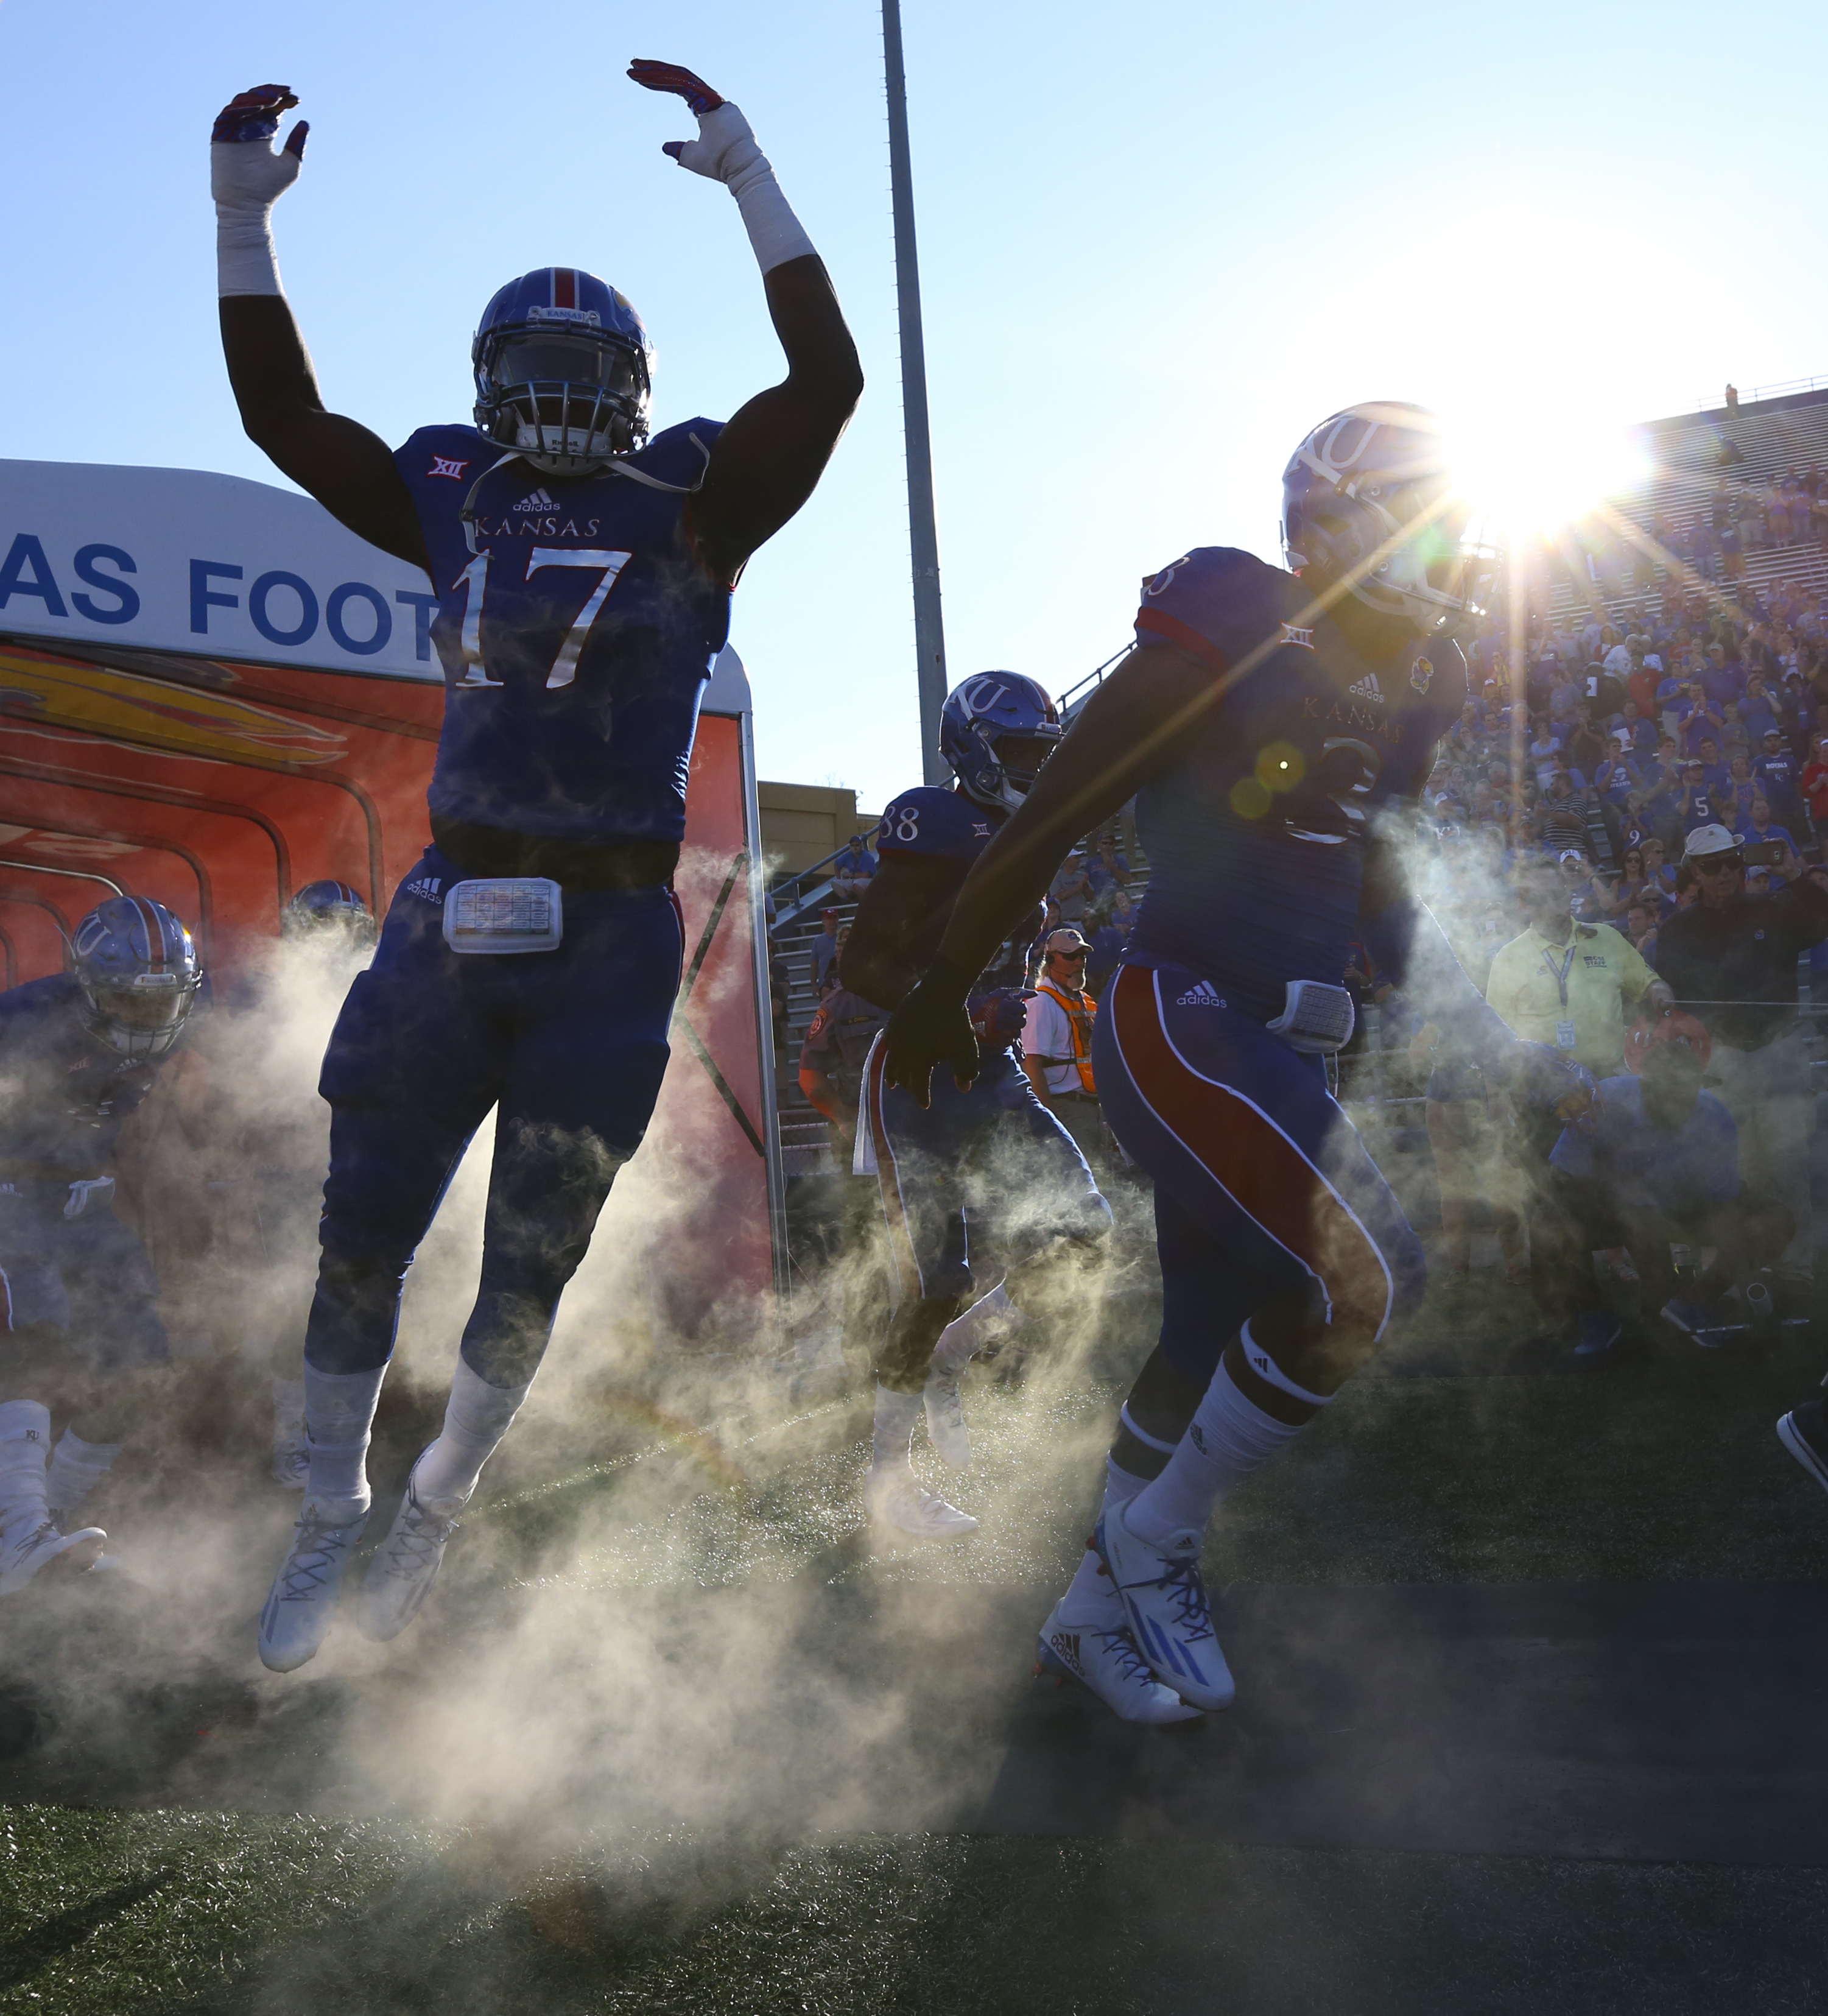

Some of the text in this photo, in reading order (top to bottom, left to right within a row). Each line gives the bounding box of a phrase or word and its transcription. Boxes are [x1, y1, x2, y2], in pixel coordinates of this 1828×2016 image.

[547, 310, 583, 320] KANSAS
[428, 455, 468, 480] XII
[513, 501, 561, 512] adidas
[473, 517, 600, 537] KANSAS
[0, 532, 440, 662] AS FOOT
[452, 546, 633, 689] 17
[1280, 622, 1315, 650] XII
[949, 675, 1011, 721] KU
[1349, 685, 1385, 703] adidas
[1301, 697, 1405, 744] KANSAS
[1695, 797, 1709, 817] 5
[879, 805, 919, 841] 88
[1629, 830, 1640, 846] 9
[407, 883, 442, 904] adidas
[1176, 995, 1227, 1008] adidas
[26, 1429, 40, 1440] KU
[1050, 1635, 1085, 1677] adidas
